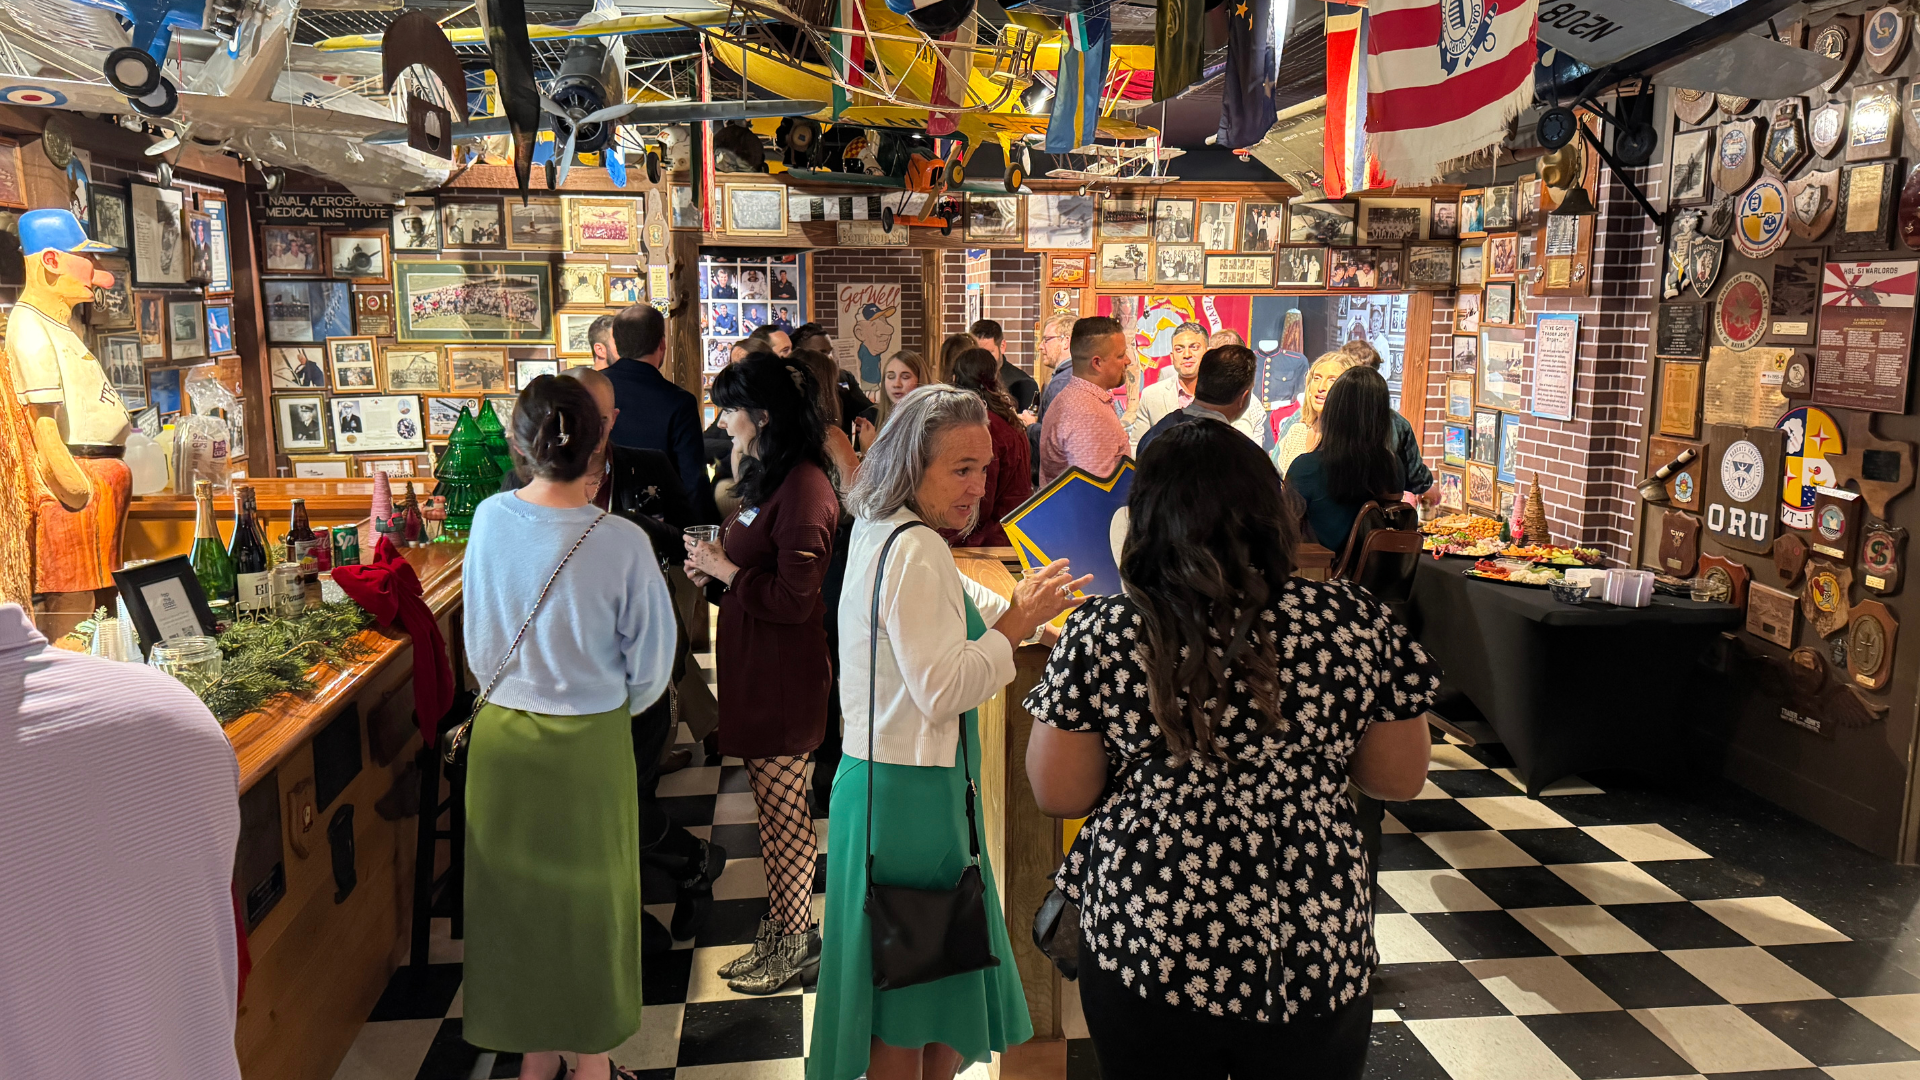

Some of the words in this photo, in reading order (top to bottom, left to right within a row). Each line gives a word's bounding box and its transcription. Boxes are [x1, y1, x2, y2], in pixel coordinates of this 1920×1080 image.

[1467, 3, 1481, 40] COAST
[1538, 2, 1624, 43] N208
[265, 207, 319, 218] MEDICAL
[322, 208, 390, 219] INSTITUTE
[268, 195, 306, 206] NAVAL
[840, 228, 890, 244] Bourbon
[1843, 267, 1855, 275] HSL
[1866, 267, 1899, 275] WARLORDS
[840, 285, 867, 314] Get
[865, 284, 901, 308] Well
[1718, 275, 1743, 306] DEPARTMENT
[1761, 290, 1769, 310] NAVY
[1707, 502, 1769, 542] ORU
